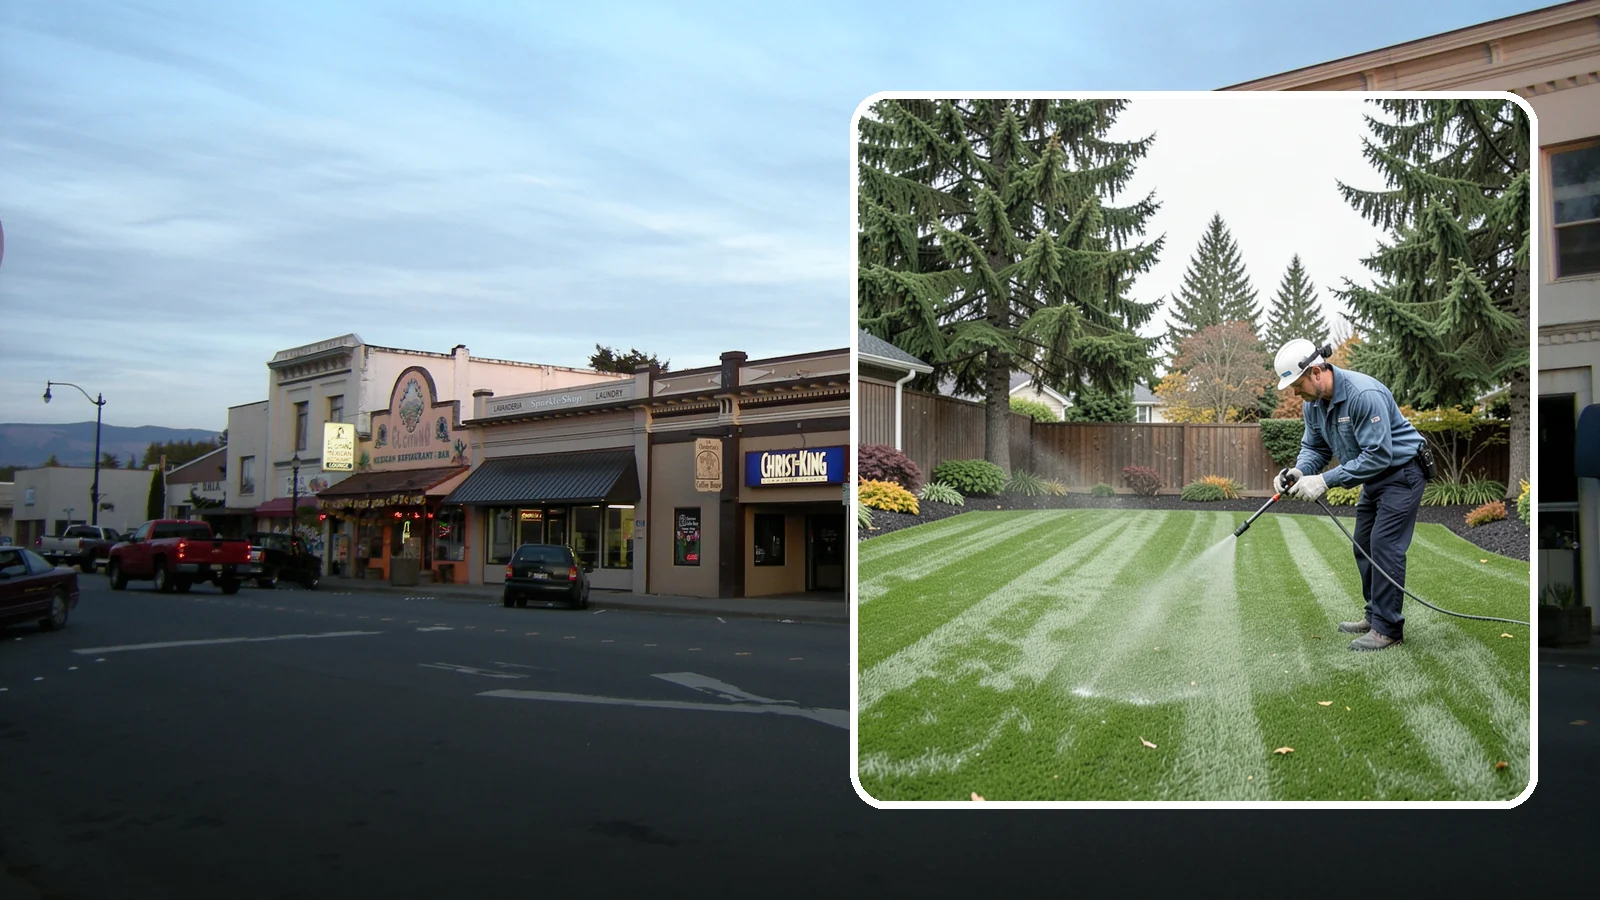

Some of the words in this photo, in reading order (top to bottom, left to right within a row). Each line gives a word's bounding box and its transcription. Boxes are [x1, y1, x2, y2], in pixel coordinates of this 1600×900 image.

[531, 399, 560, 409] Sparkle
[562, 394, 582, 405] Shop
[595, 389, 623, 399] LAUNDRY
[494, 402, 522, 412] LAVANDERIA
[391, 425, 402, 449] EL
[327, 449, 353, 457] MEXICAN
[374, 456, 396, 464] MEXICAN
[398, 451, 433, 461] RESTAURANT
[438, 449, 450, 459] BAR
[761, 452, 797, 478] CHRIST
[799, 450, 827, 476] KING
